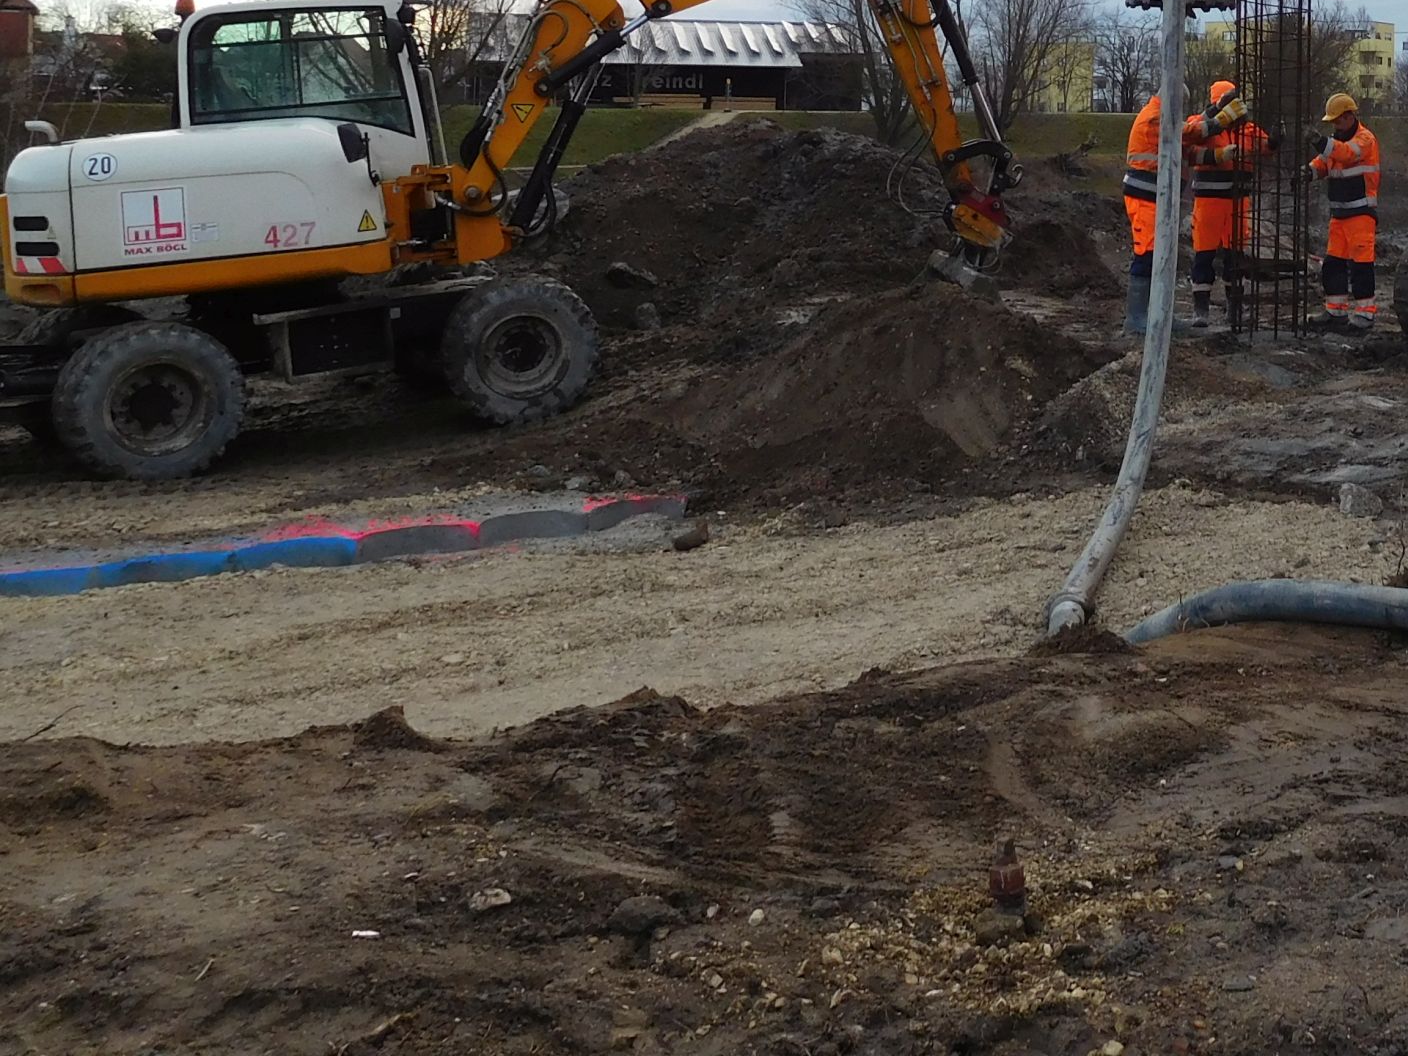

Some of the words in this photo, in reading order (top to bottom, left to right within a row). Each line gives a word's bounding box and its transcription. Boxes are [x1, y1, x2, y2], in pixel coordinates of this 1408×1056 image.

[631, 72, 704, 90] reindl
[88, 156, 111, 175] 20
[264, 221, 316, 248] 427
[124, 246, 153, 256] MAX
